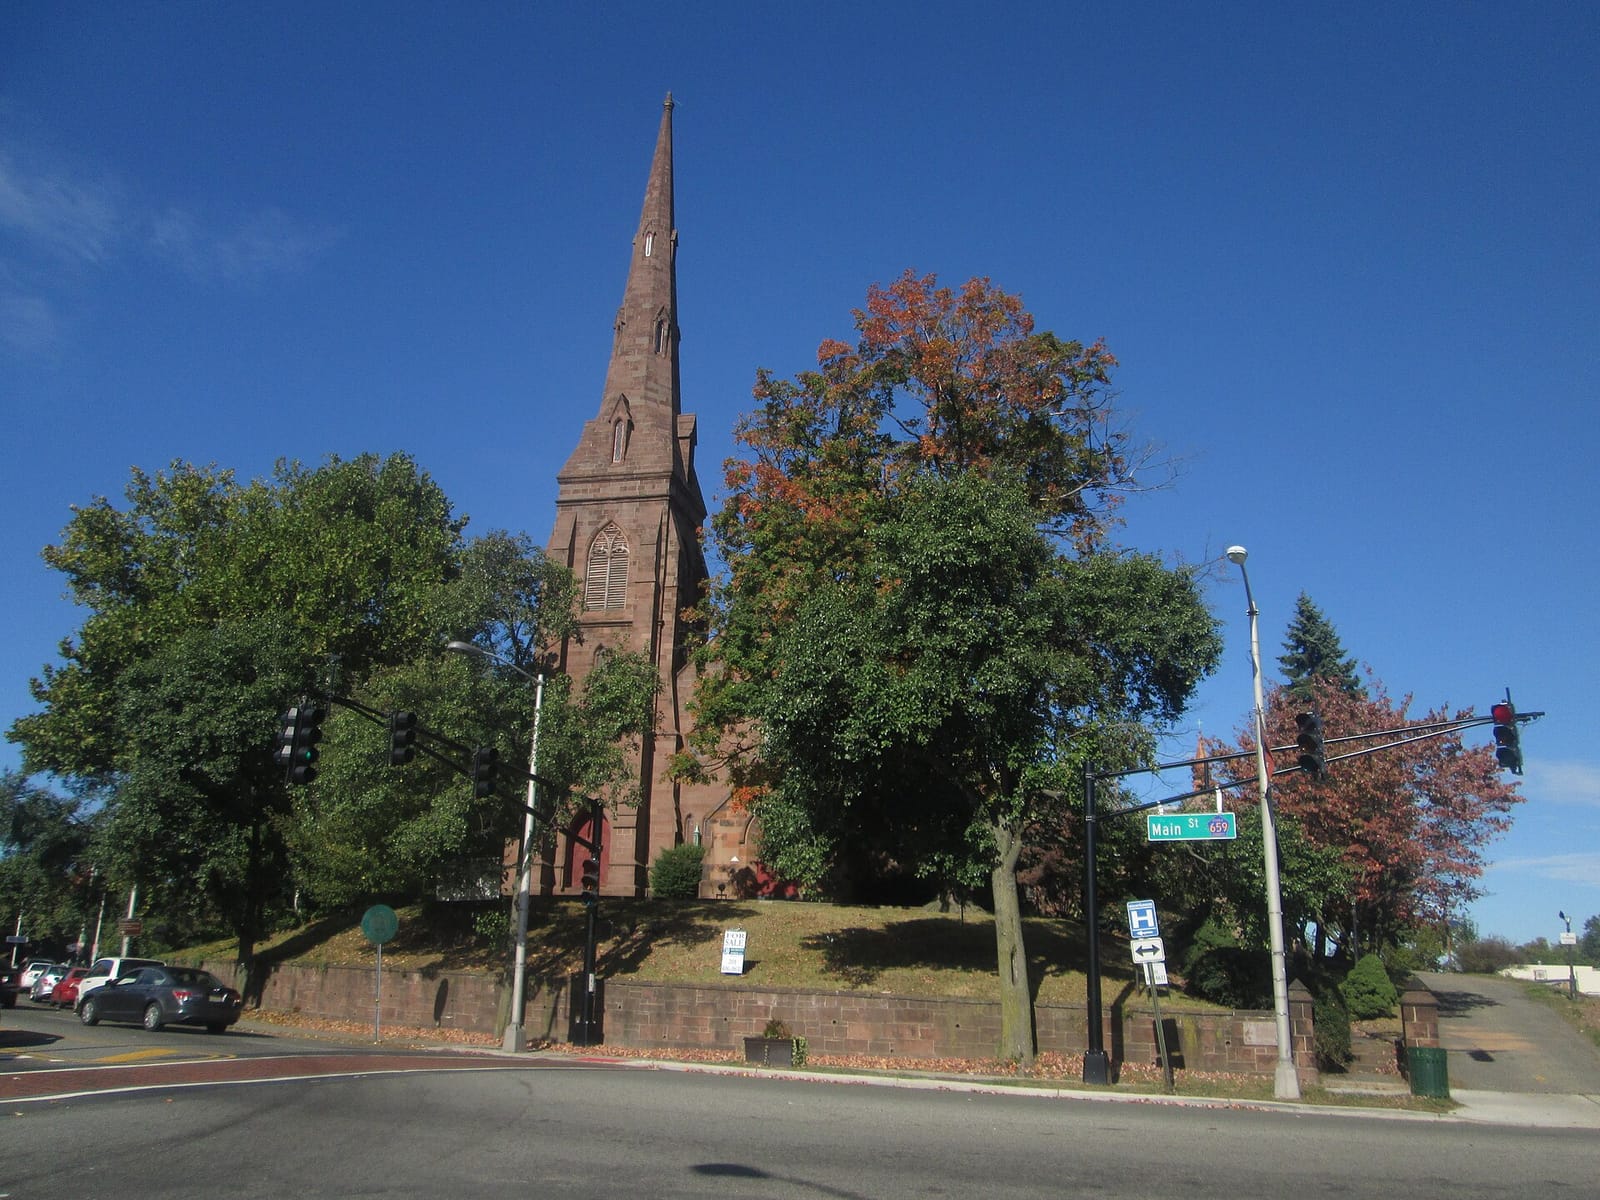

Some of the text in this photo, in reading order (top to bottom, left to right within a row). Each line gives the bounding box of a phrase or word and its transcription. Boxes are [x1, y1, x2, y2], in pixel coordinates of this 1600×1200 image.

[1152, 818, 1228, 836] Main St 659
[1131, 909, 1155, 929] H
[725, 939, 744, 947] SALE
